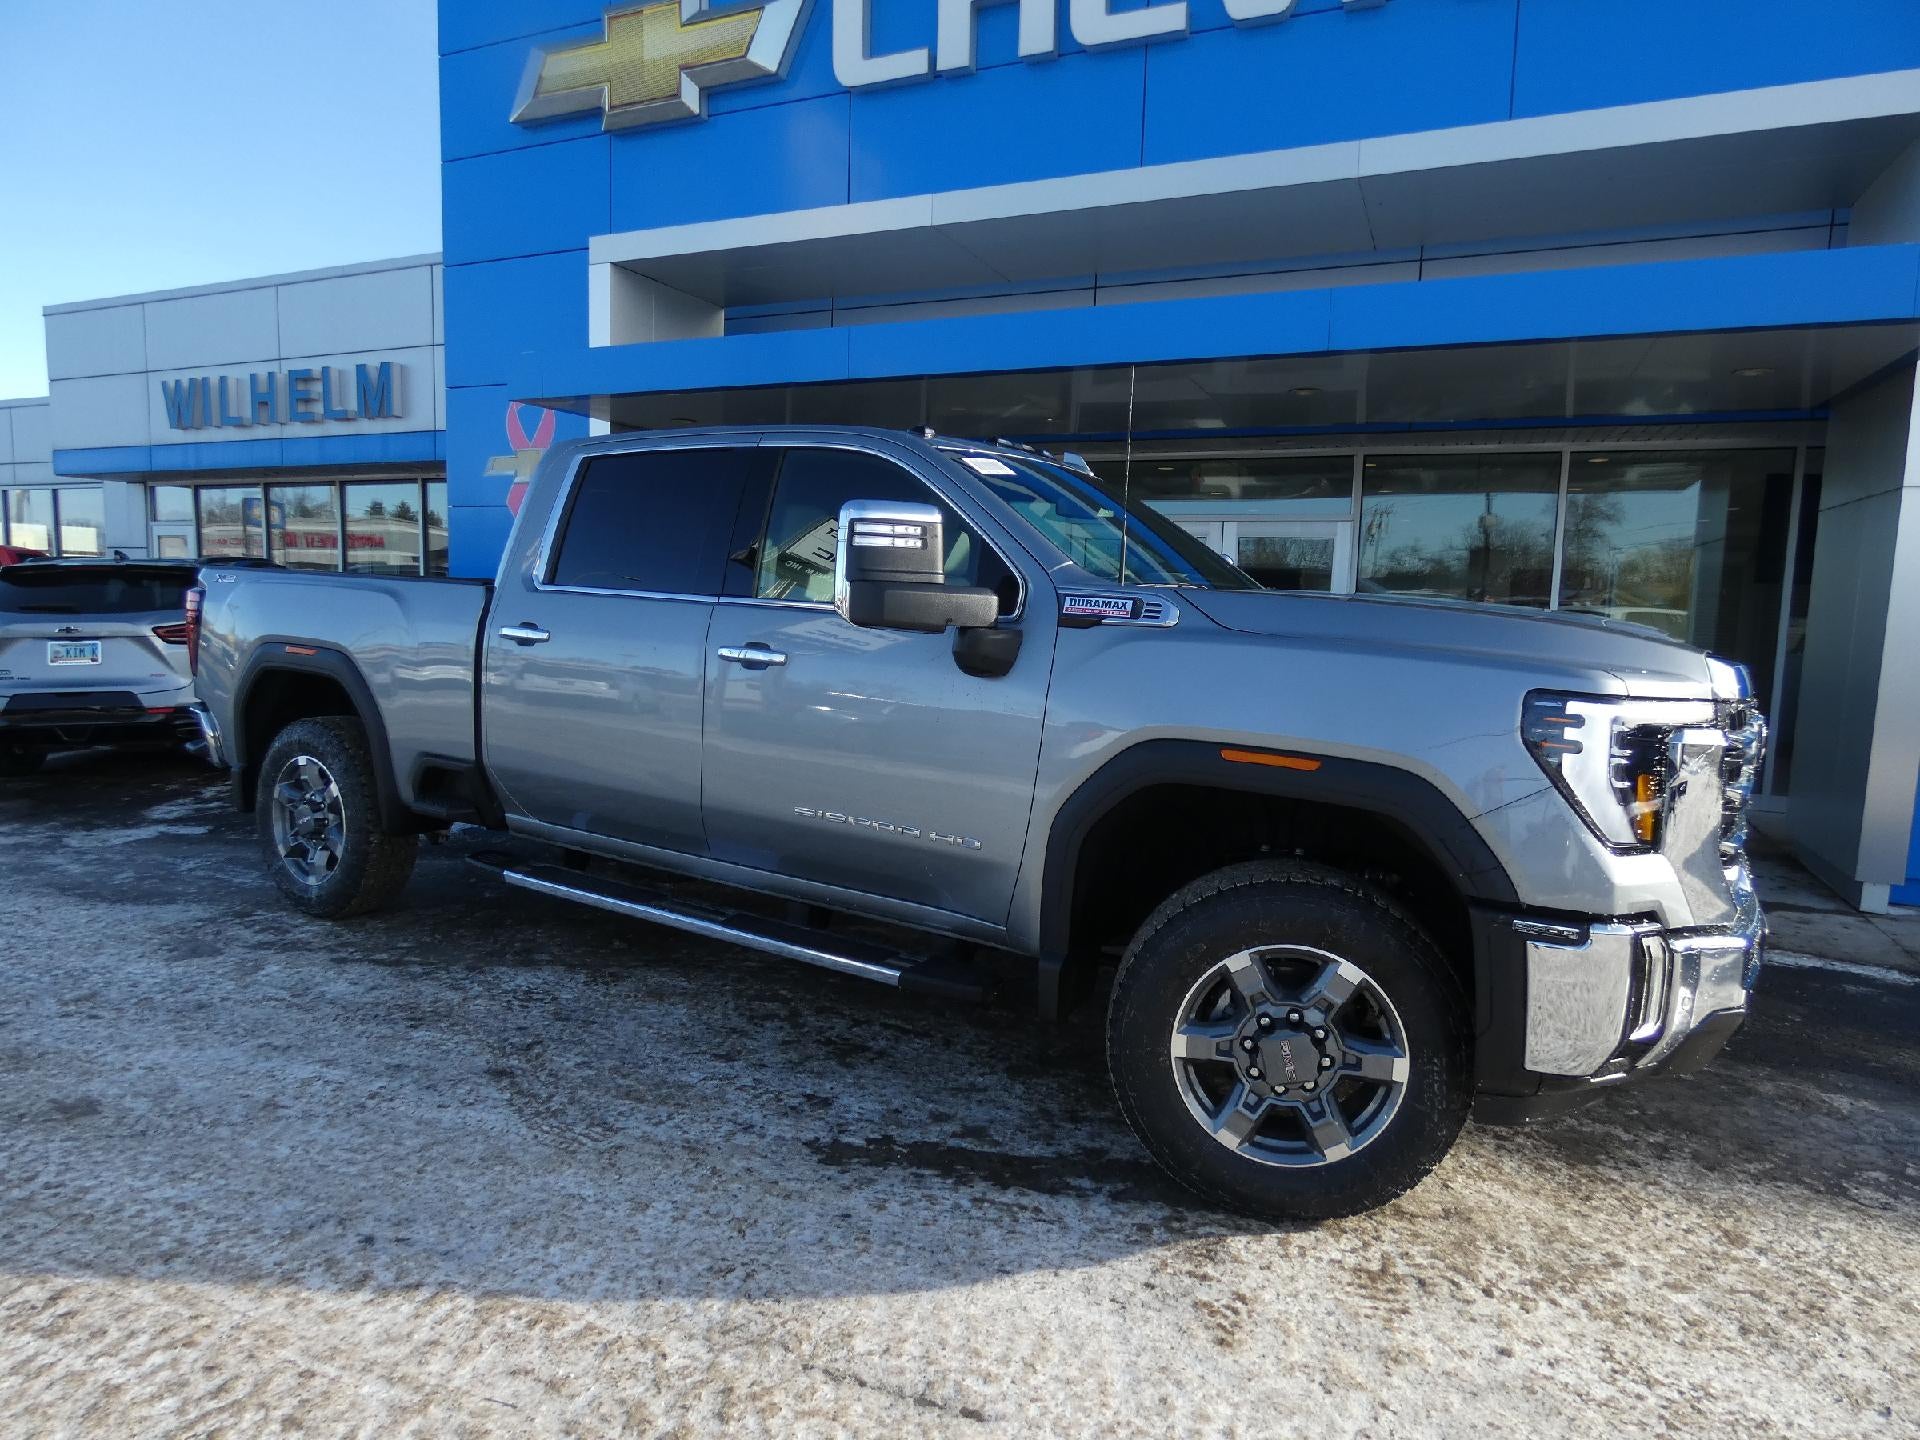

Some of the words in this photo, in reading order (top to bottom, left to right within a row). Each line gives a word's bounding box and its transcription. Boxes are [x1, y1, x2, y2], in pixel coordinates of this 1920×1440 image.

[162, 361, 398, 430] WILHELM
[1069, 598, 1128, 610] DURAMAX
[66, 647, 86, 658] KIM
